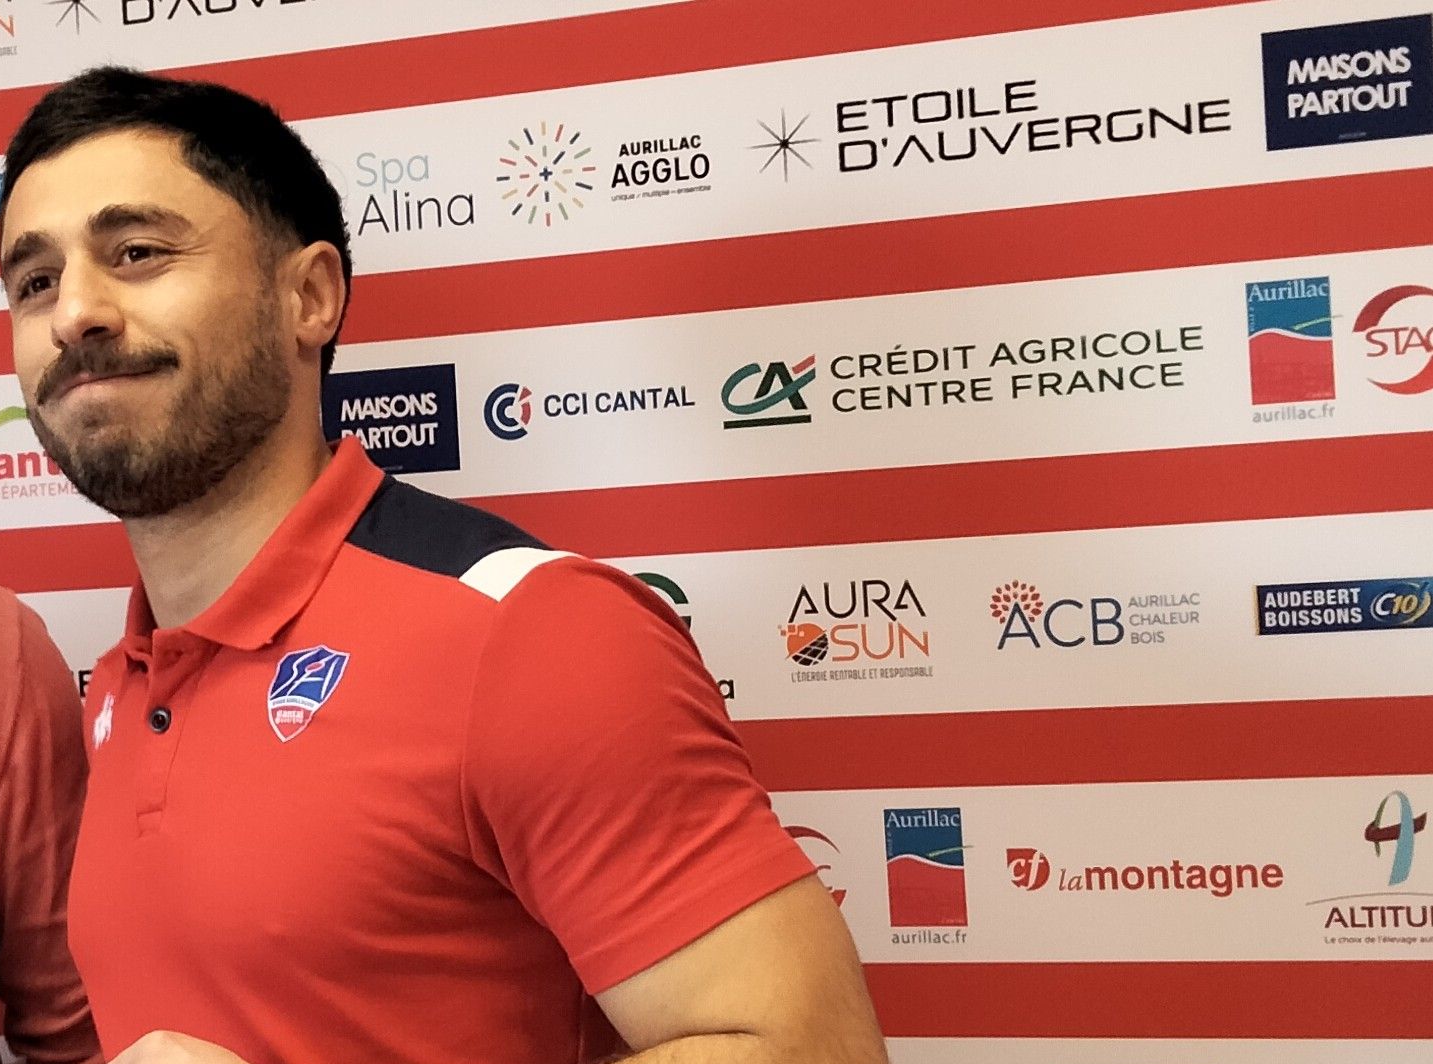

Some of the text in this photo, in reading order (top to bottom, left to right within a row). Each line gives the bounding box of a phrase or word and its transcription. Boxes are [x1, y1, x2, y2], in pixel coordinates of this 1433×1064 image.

[1287, 47, 1411, 84] MAISONS
[838, 80, 1038, 132] ETOILE
[1287, 81, 1412, 119] PARTOUT
[619, 135, 702, 156] AURILLAC
[838, 99, 1231, 172] D'AUVERGNE
[356, 151, 429, 194] Spa
[611, 154, 711, 188] AGGLO
[358, 189, 475, 236] Alina
[1249, 279, 1329, 302] Aurillac
[830, 325, 1204, 380] CRÉDIT AGRICOLE
[544, 385, 695, 418] CCI CANTAL
[831, 361, 1185, 413] CENTRE FRANCE
[340, 392, 438, 422] MAISONS
[1252, 404, 1335, 423] aurillac.fr
[341, 421, 438, 450] PARTOUT
[787, 580, 926, 624] AURA
[1128, 592, 1200, 608] AURILLAC
[1264, 587, 1361, 608] AUDEBERT
[997, 597, 1124, 650] ACB
[1128, 611, 1200, 627] CHALEUR
[1265, 607, 1363, 627] BOISSONS
[831, 621, 929, 662] SUN
[1130, 630, 1165, 646] BOIS
[886, 810, 960, 829] Aurillac
[1325, 905, 1433, 928] ALTITU
[892, 929, 967, 945] aurillac.fr
